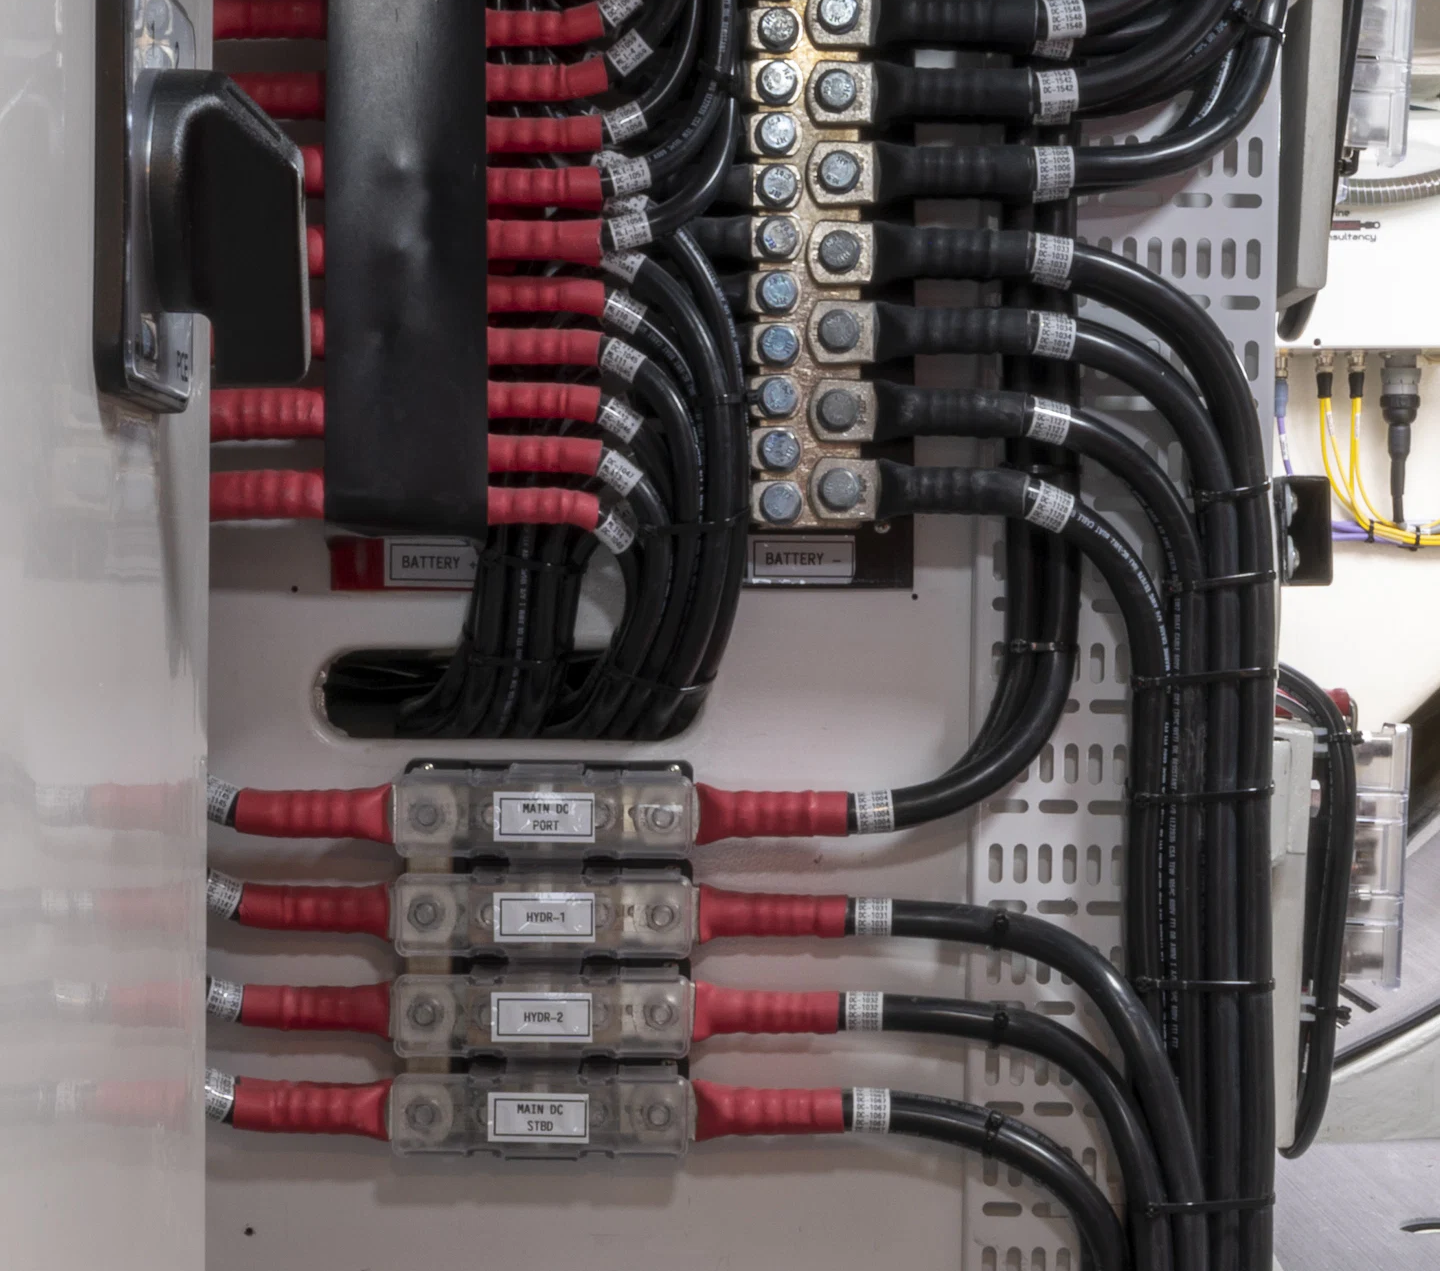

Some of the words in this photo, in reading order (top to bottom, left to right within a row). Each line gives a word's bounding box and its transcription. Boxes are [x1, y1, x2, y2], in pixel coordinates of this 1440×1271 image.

[1051, 6, 1081, 16] DC-1548
[1052, 14, 1082, 24] DC-1548
[1041, 77, 1072, 86] DC-1542
[1043, 84, 1074, 94] DC-1542
[1039, 157, 1070, 166] DC-1006
[1040, 165, 1070, 173] DC-1006
[1328, 232, 1377, 243] nsultancy
[402, 555, 460, 568] BATTERY
[766, 553, 824, 566] BATTERY
[859, 794, 888, 803] DC-1004
[523, 803, 551, 814] MAIN
[556, 803, 569, 814] DC
[860, 810, 889, 819] DC-1004
[532, 820, 560, 831] PORT
[858, 904, 888, 912] DC-1031
[526, 912, 566, 923] HYDR-1
[848, 996, 878, 1004] DC-1032
[523, 1012, 564, 1023] HYDR-2
[517, 1104, 546, 1115] MAIN
[550, 1104, 563, 1115] DC
[856, 1103, 886, 1112] DC-1067
[856, 1112, 886, 1121] DC-1067
[527, 1121, 554, 1132] STBD
